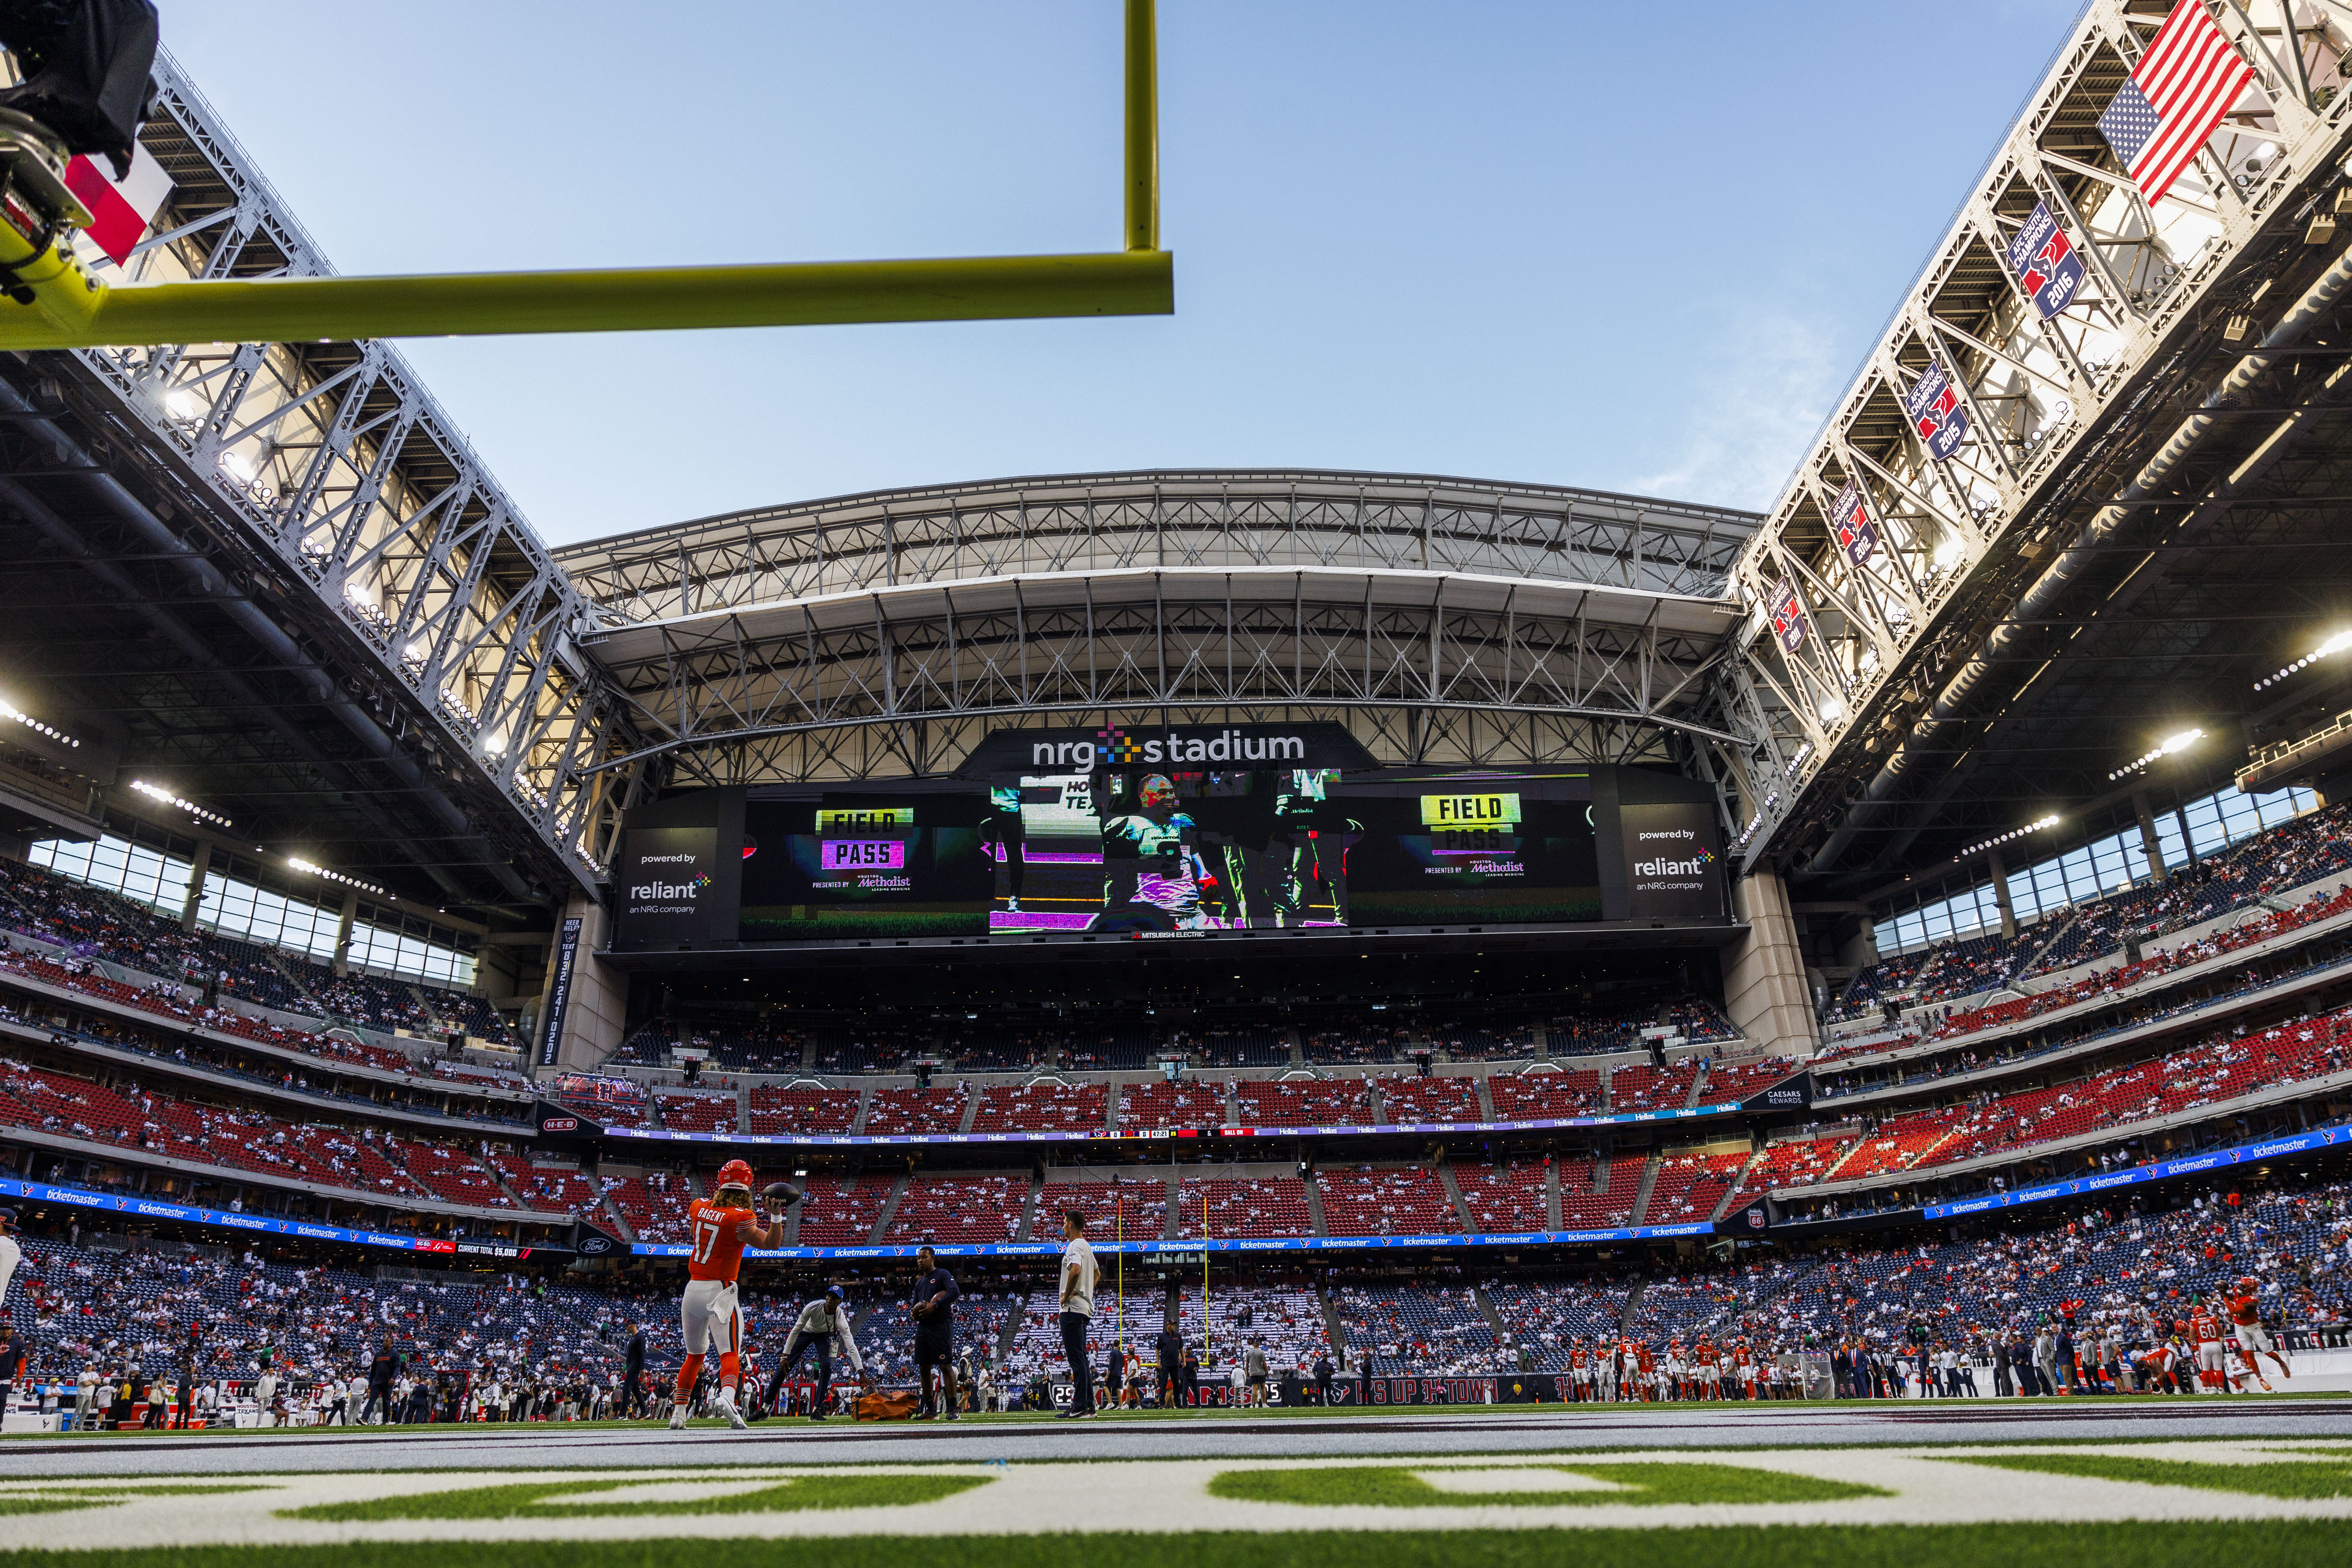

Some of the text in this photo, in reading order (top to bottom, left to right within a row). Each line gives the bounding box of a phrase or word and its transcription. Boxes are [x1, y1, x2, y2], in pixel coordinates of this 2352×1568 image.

[2013, 211, 2042, 255] AFC SOUTH
[2014, 213, 2051, 270] CHAMPIONS
[2047, 271, 2074, 309] 2016
[1911, 369, 1935, 404] AFC SOUTH
[1911, 372, 1942, 416] CHAMPIONS
[1938, 421, 1960, 453] 2015
[1833, 486, 1852, 515] AFC SOUTH
[1833, 490, 1856, 525] CHAMPIONS
[1854, 535, 1872, 561] 2012
[1774, 581, 1784, 597] SOUTH
[1770, 585, 1789, 615] CHAMPIONS
[1788, 626, 1801, 647] 2011
[1033, 730, 1304, 773] nrg stadium
[1439, 797, 1502, 820] FIELD
[834, 813, 895, 833] FIELD
[1445, 828, 1500, 850] PASS
[1639, 830, 1694, 841] powered by
[641, 854, 696, 864] powered by
[836, 843, 890, 864] PASS
[1471, 861, 1524, 873] Methodist
[1635, 857, 1703, 876] reliant
[631, 881, 697, 899] reliant
[858, 876, 910, 888] Methodist
[1667, 882, 1703, 890] company
[1676, 1109, 1696, 1117] Hellas
[1717, 1104, 1736, 1112] Hellas
[630, 1129, 649, 1138] Hellas
[2253, 1140, 2306, 1158] ticketmaster
[2168, 1158, 2215, 1174] ticketmaster
[2090, 1173, 2134, 1189] ticketmaster
[47, 1189, 100, 1205] ticketmaster
[2019, 1188, 2057, 1202] ticketmaster
[139, 1203, 185, 1218] ticketmaster
[697, 1207, 726, 1223] BAGENT
[1952, 1201, 1989, 1214] ticketmaster
[221, 1215, 266, 1228] ticketmaster
[298, 1226, 338, 1238] ticketmaster
[1568, 1232, 1614, 1241] ticketmaster
[1652, 1226, 1698, 1236] ticketmaster
[368, 1235, 406, 1246] ticketmaster
[585, 1240, 604, 1251] Ford
[693, 1220, 719, 1265] 17
[1240, 1240, 1286, 1248] ticketmaster
[458, 1245, 517, 1257] CURRENT TOTAL $5,000
[835, 1248, 880, 1256] ticketmaster
[2199, 1324, 2217, 1339] 60
[1575, 1357, 1584, 1366] 39
[1703, 1352, 1711, 1361] 22
[1392, 1380, 1416, 1404] UP
